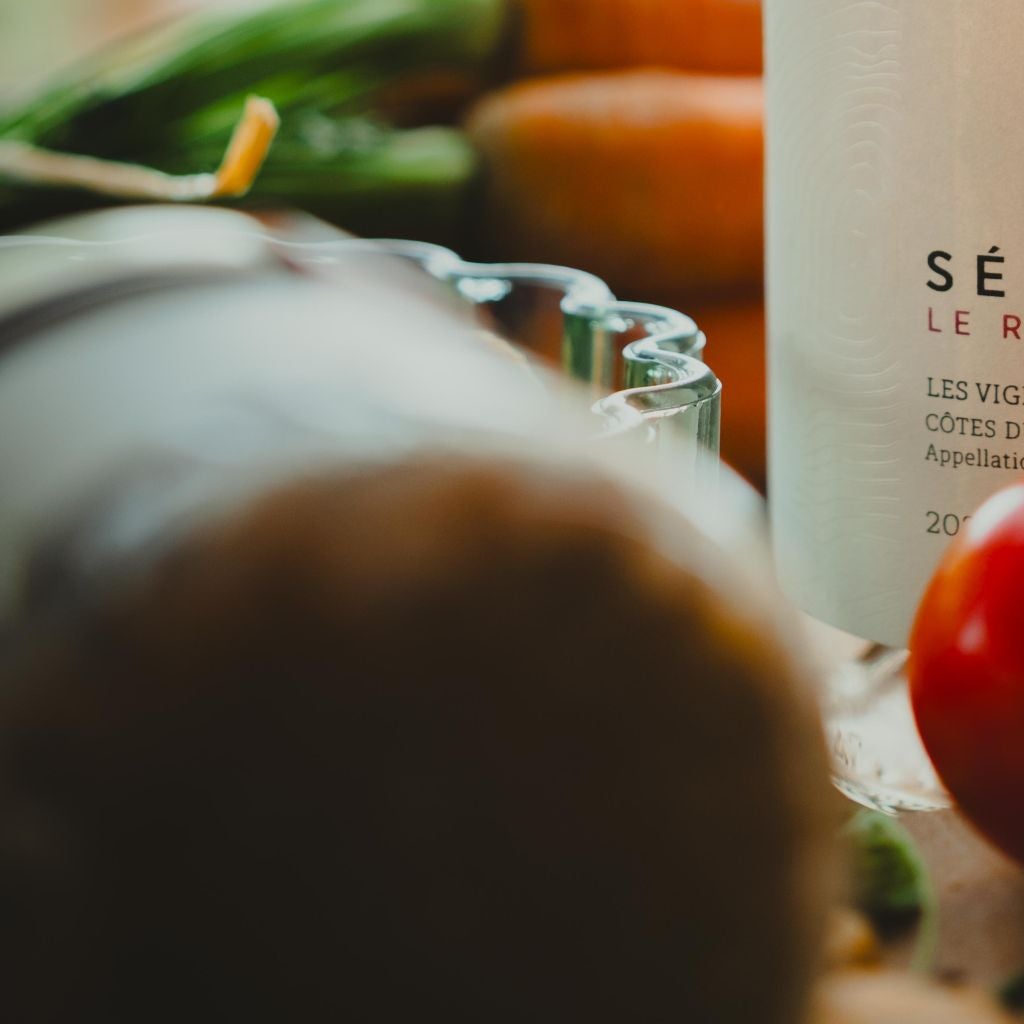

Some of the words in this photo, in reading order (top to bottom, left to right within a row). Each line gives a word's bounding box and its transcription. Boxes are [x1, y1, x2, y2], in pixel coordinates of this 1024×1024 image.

[927, 307, 971, 336] LE
[927, 377, 968, 401] LES
[925, 412, 996, 438] CÔTES
